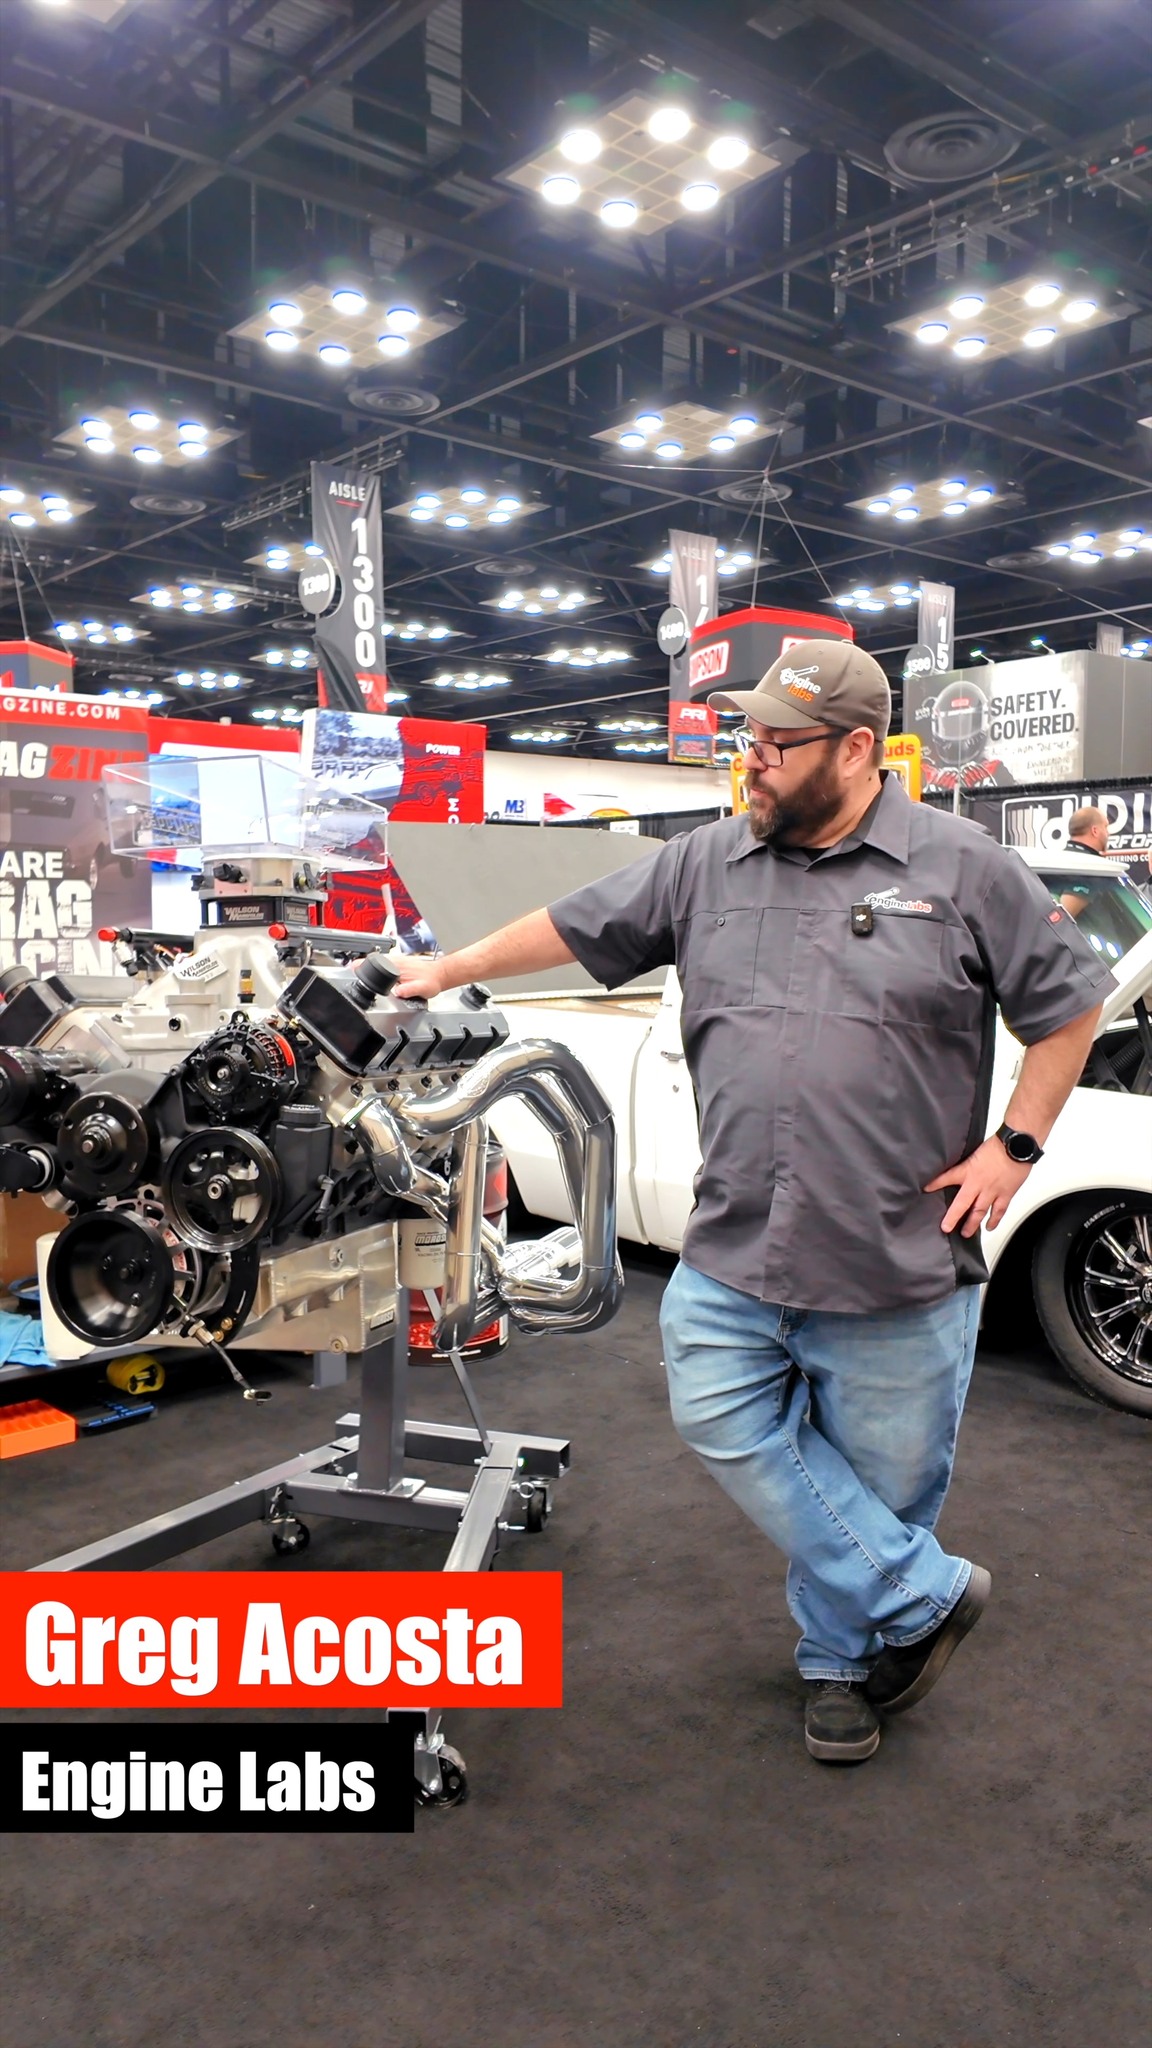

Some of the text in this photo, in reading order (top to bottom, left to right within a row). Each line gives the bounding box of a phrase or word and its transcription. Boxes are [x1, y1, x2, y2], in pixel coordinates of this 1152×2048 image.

[328, 481, 366, 501] AISLE
[681, 546, 707, 561] AISLE
[302, 573, 330, 596] 1300
[351, 517, 377, 668] 1300
[907, 656, 932, 674] 1500
[787, 683, 814, 702] labs
[990, 688, 1067, 717] SAFETY.
[0, 696, 121, 720] GZINE.COM
[680, 707, 707, 721] PRI
[990, 712, 1079, 742] COVERED.
[425, 743, 461, 756] POWER
[0, 851, 64, 879] ARE
[224, 905, 260, 917] WILSON
[181, 956, 212, 979] WILSON
[415, 1233, 447, 1247] MOROS
